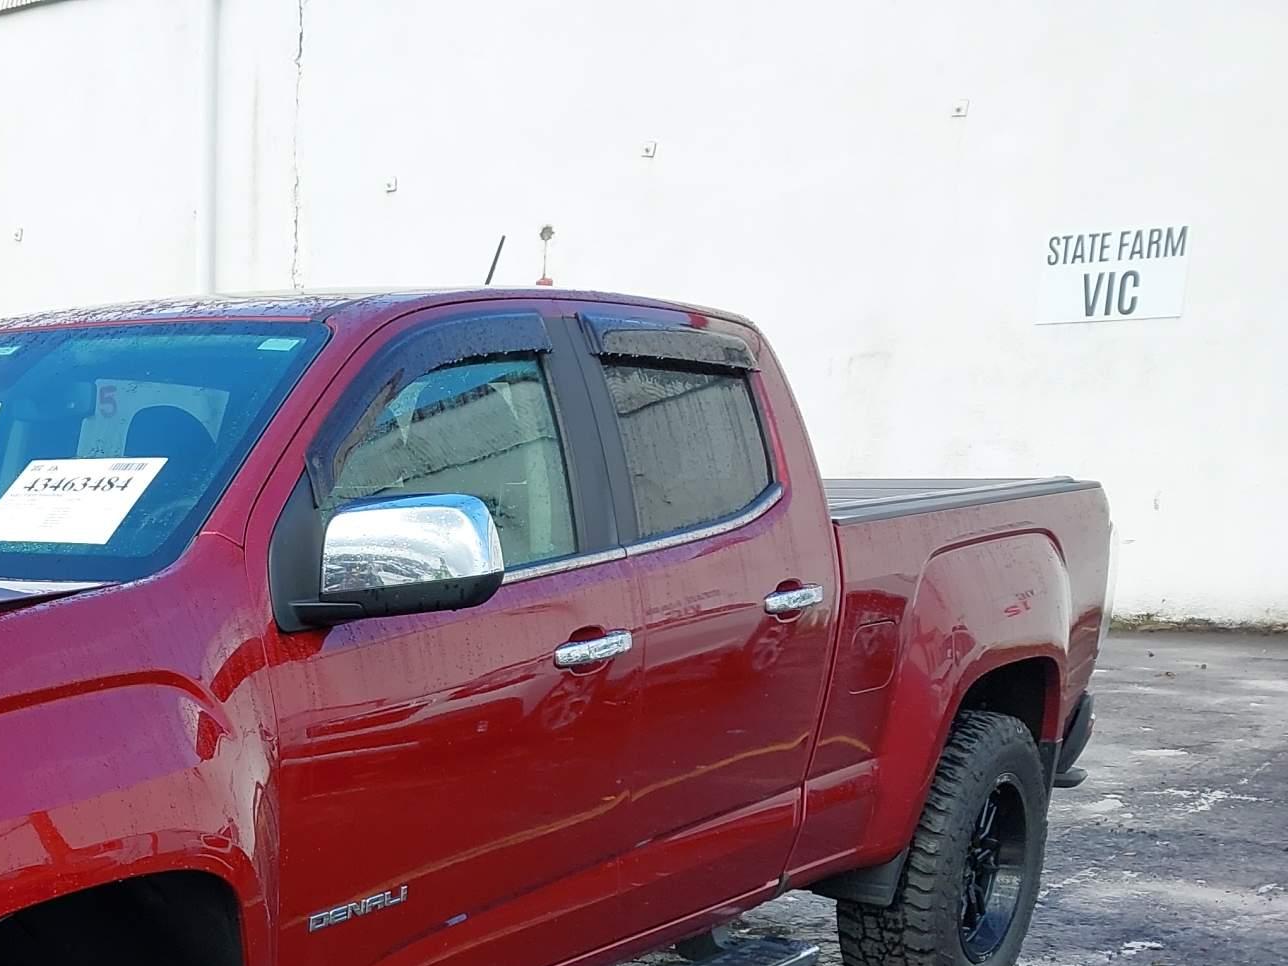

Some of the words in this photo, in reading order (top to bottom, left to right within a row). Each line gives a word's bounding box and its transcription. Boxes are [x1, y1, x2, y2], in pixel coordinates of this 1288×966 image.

[1047, 232, 1112, 266] STATE
[1118, 225, 1189, 262] FARM
[1083, 270, 1140, 317] VIC
[24, 476, 135, 493] 43463484
[308, 885, 408, 932] DENALI
